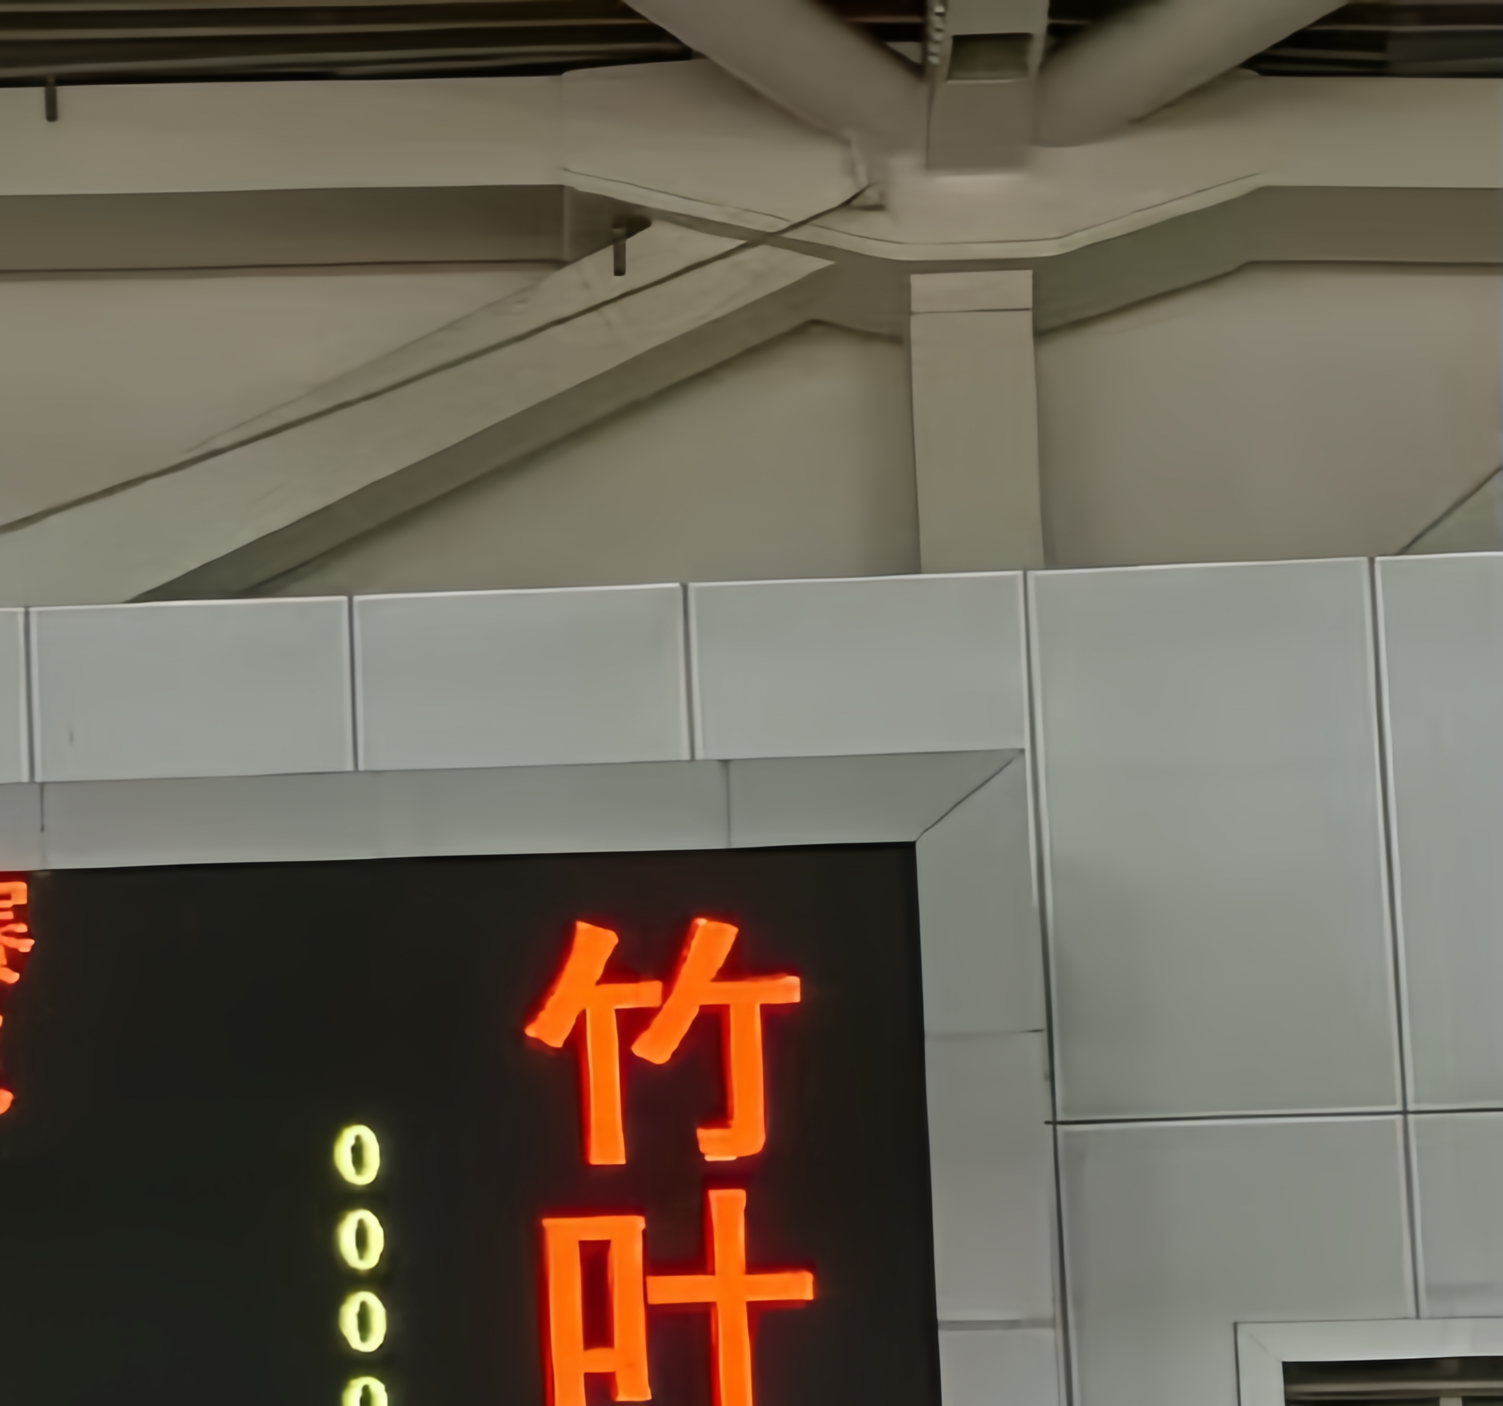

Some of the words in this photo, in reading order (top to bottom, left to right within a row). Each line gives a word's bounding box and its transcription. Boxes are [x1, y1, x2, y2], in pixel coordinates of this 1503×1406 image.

[334, 1125, 380, 1186] 0
[337, 1209, 384, 1271] 0
[340, 1291, 387, 1352] 0
